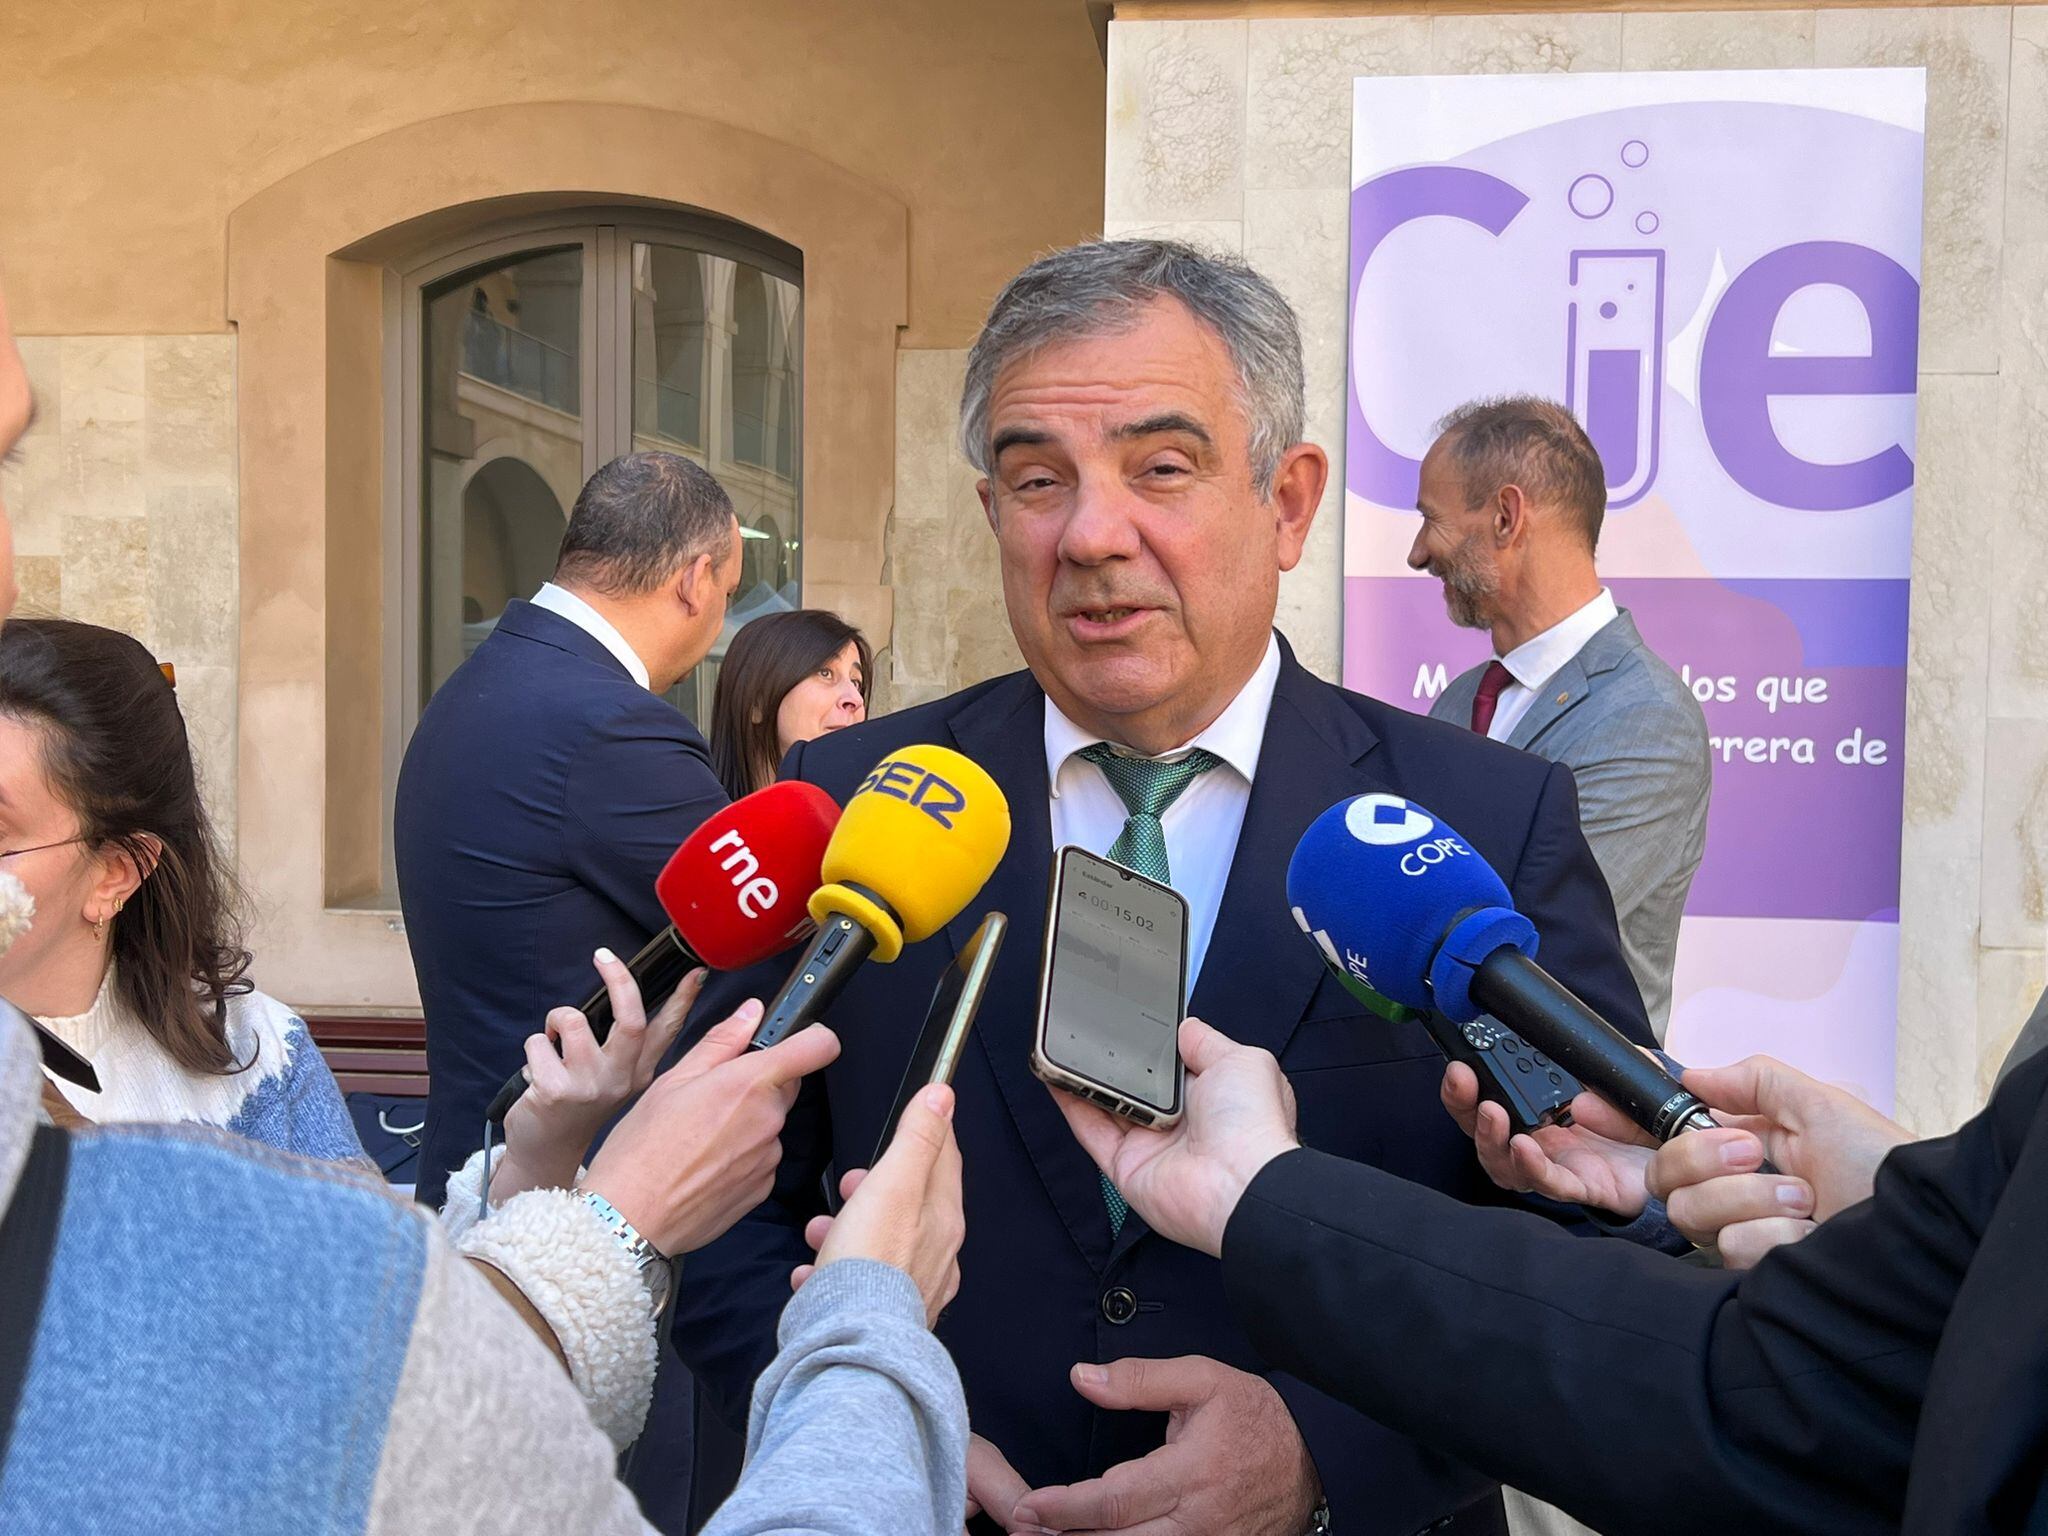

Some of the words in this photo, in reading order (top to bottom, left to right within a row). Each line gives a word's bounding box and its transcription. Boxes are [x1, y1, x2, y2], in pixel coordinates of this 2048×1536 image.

[1756, 676, 1828, 713] que
[1836, 727, 1888, 765] de
[709, 829, 779, 919] rne
[1400, 838, 1471, 876] COPE
[1346, 948, 1376, 990] OPE
